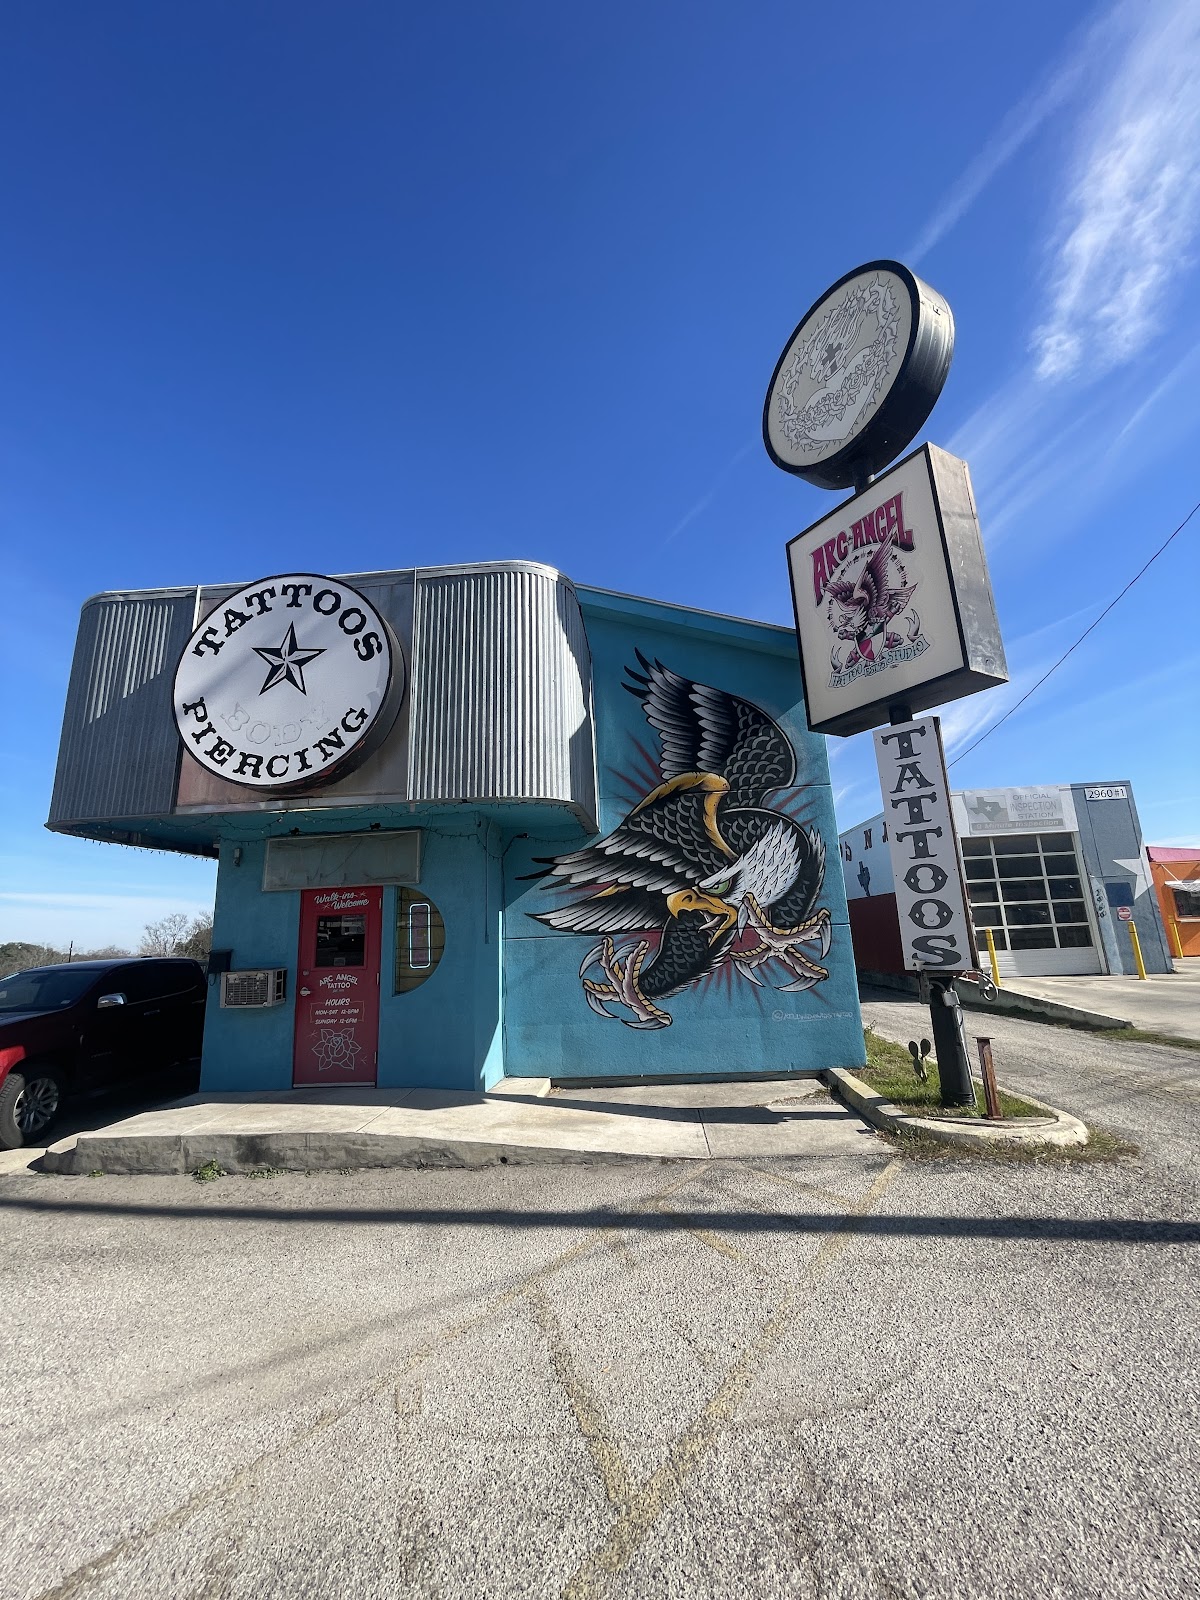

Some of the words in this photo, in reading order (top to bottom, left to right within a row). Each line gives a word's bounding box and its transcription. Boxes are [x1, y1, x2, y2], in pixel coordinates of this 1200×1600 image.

[810, 530, 849, 607] ARC
[849, 491, 915, 553] ANGEL
[191, 583, 383, 662] TATTOOS
[887, 640, 924, 663] STUDIO
[182, 697, 369, 779] PIERCING
[1010, 801, 1057, 812] INSPECTION
[1015, 819, 1059, 828] Inspection
[881, 725, 962, 967] TATTOOS
[331, 899, 369, 910] Welcome
[320, 975, 333, 987] ARC
[336, 974, 358, 985] ANGEL
[325, 998, 351, 1006] HOURS
